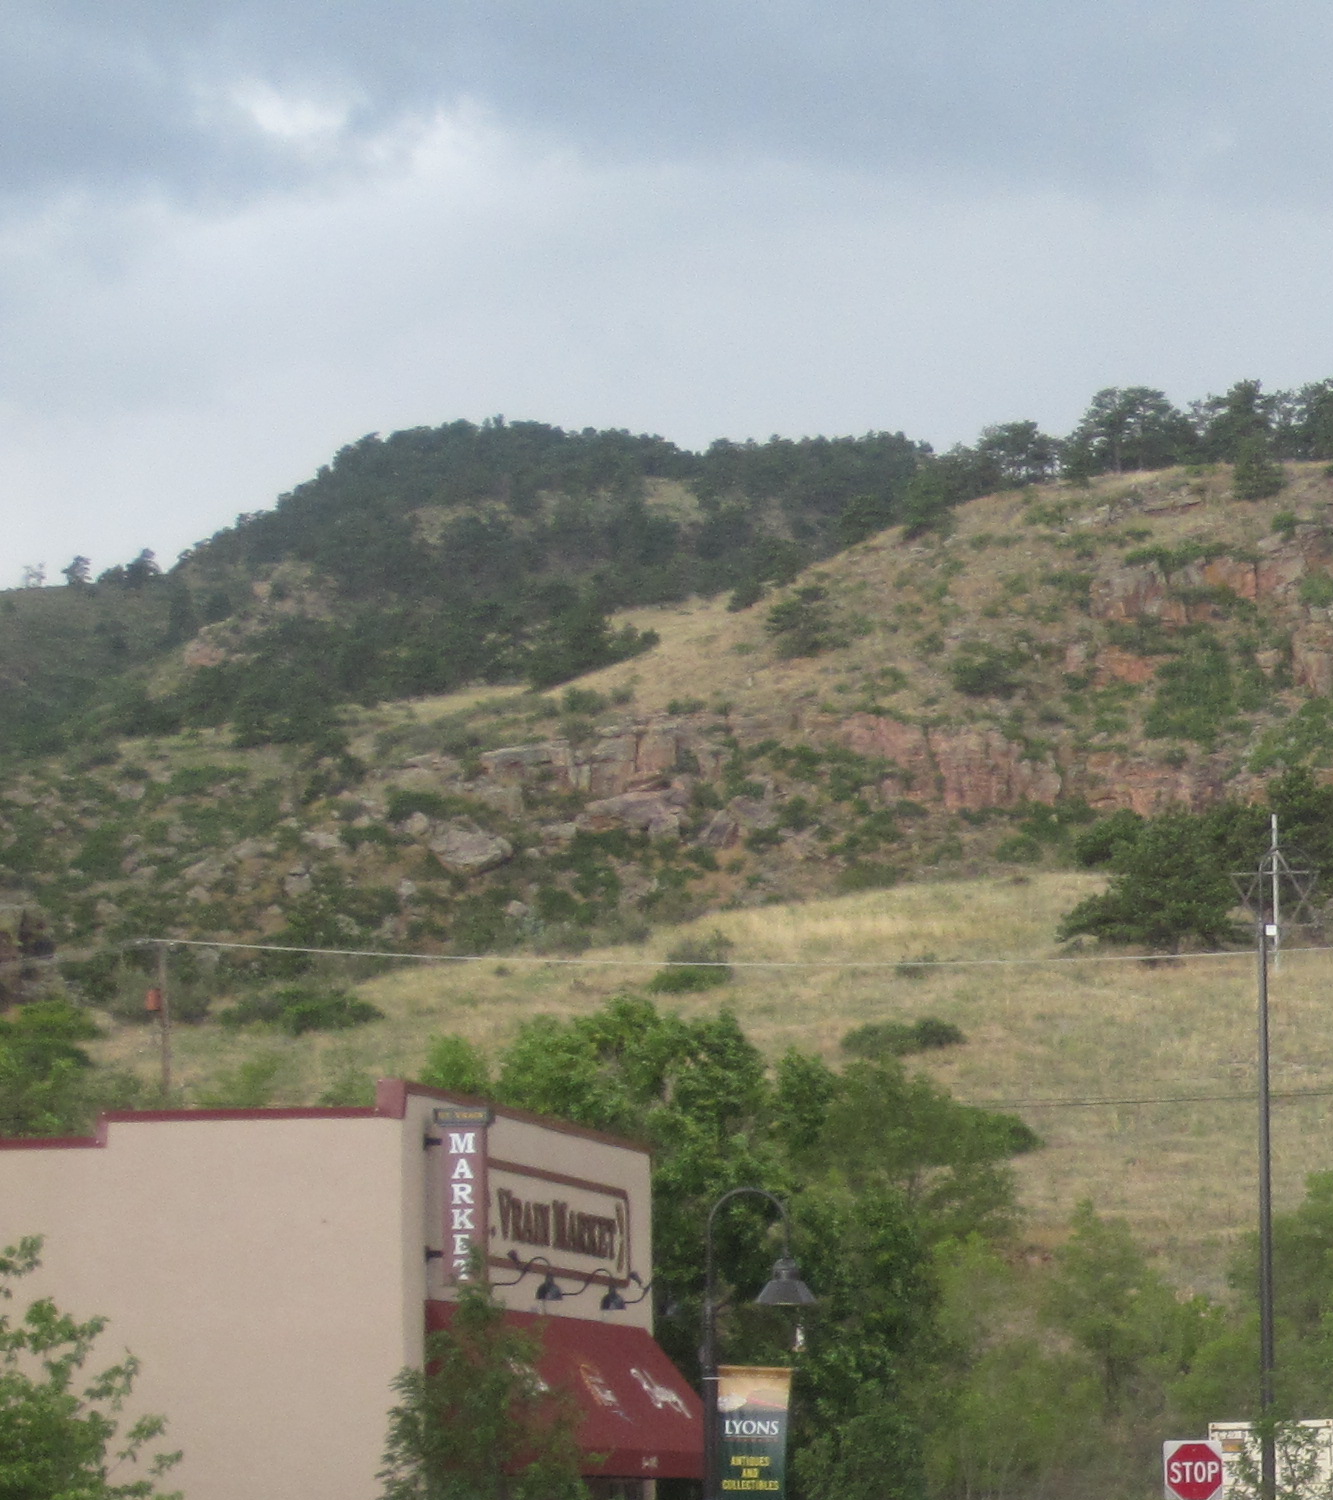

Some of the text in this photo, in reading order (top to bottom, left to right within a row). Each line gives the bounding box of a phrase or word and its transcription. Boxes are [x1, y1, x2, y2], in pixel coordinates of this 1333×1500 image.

[724, 1420, 780, 1435] LYONS
[1170, 1461, 1219, 1484] STOP
[722, 1479, 780, 1490] COLLECTIBLES
